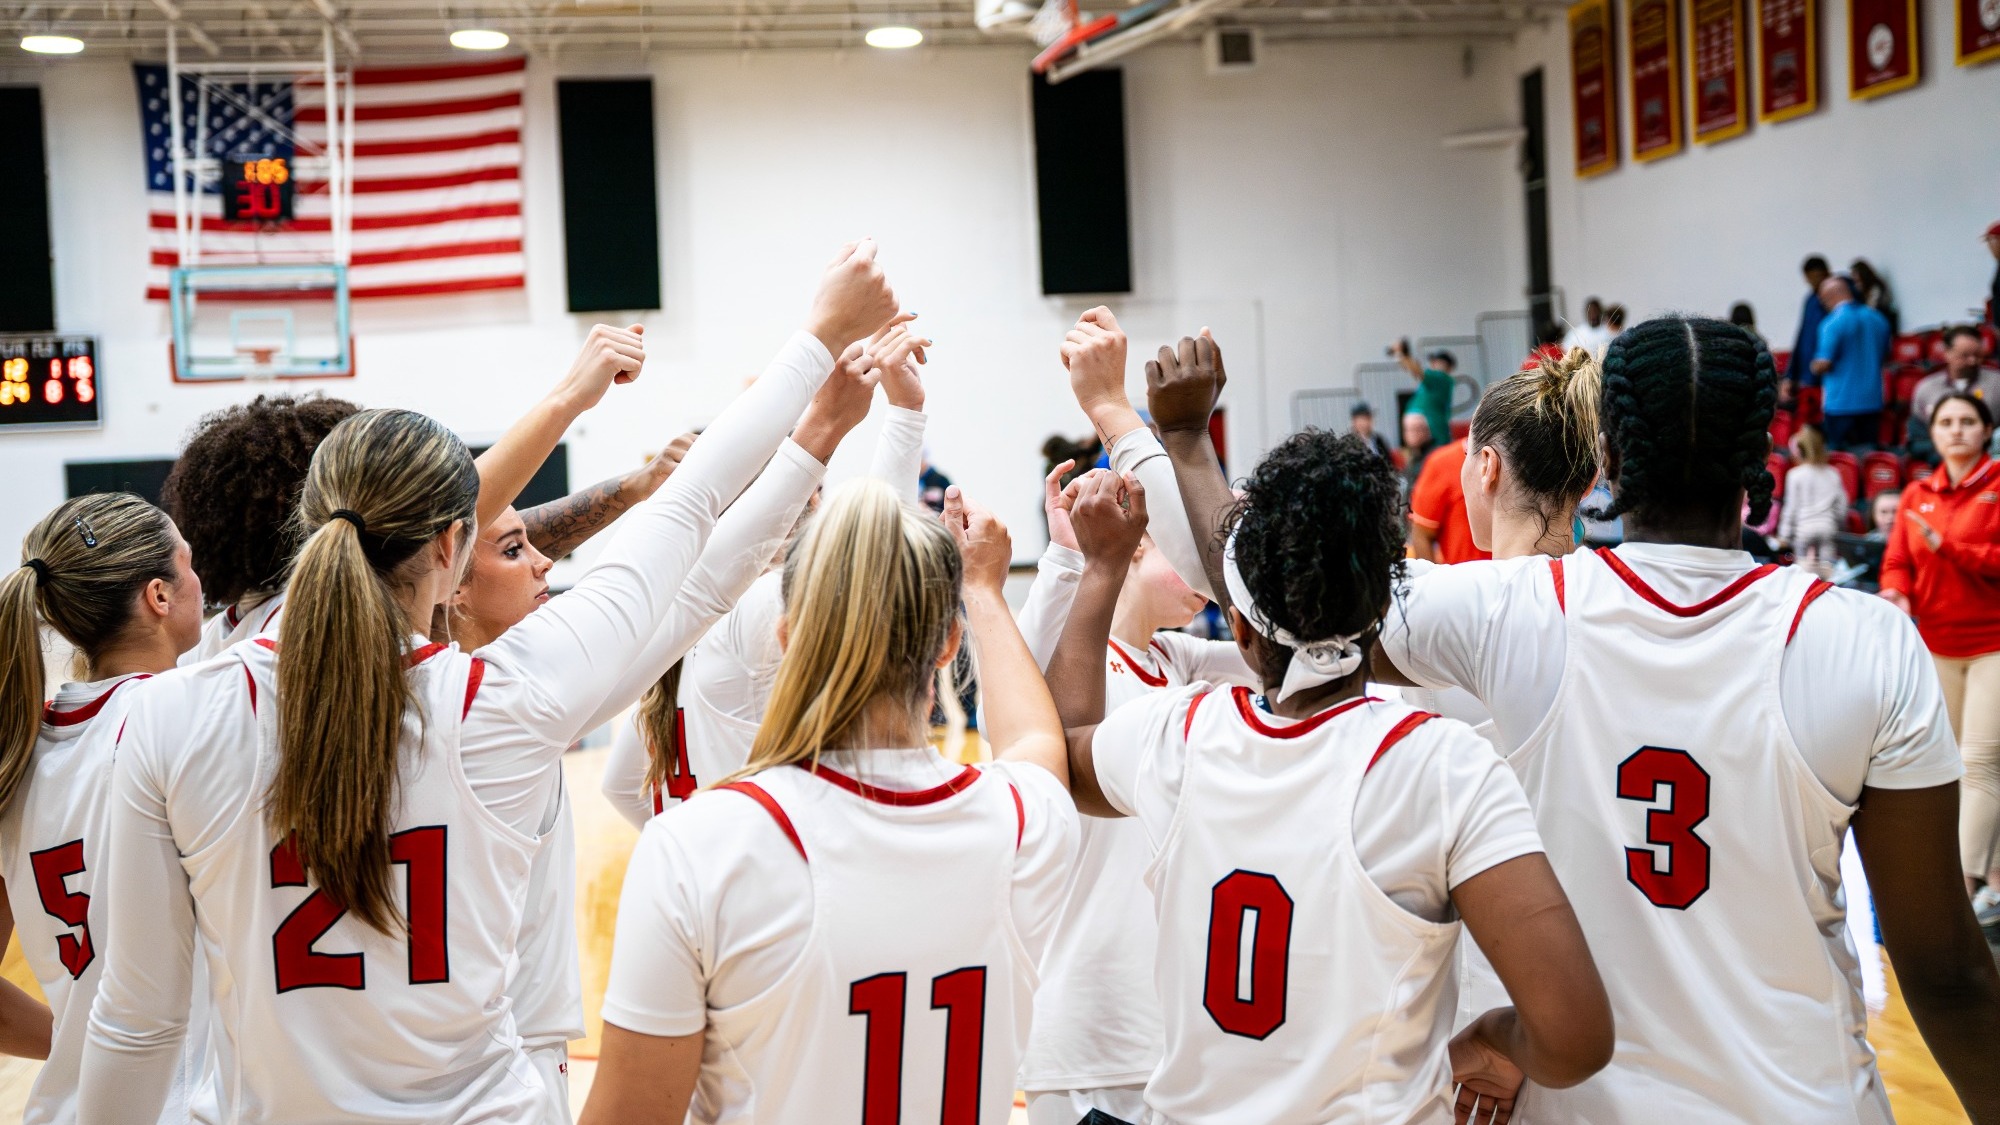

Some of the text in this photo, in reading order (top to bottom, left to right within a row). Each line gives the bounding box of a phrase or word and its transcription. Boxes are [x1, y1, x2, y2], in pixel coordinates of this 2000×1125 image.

[236, 180, 281, 218] 30
[30, 838, 95, 980] 5
[270, 825, 449, 994] 21
[1616, 745, 1711, 911] 3
[1203, 868, 1295, 1041] 0
[848, 965, 987, 1125] 11
